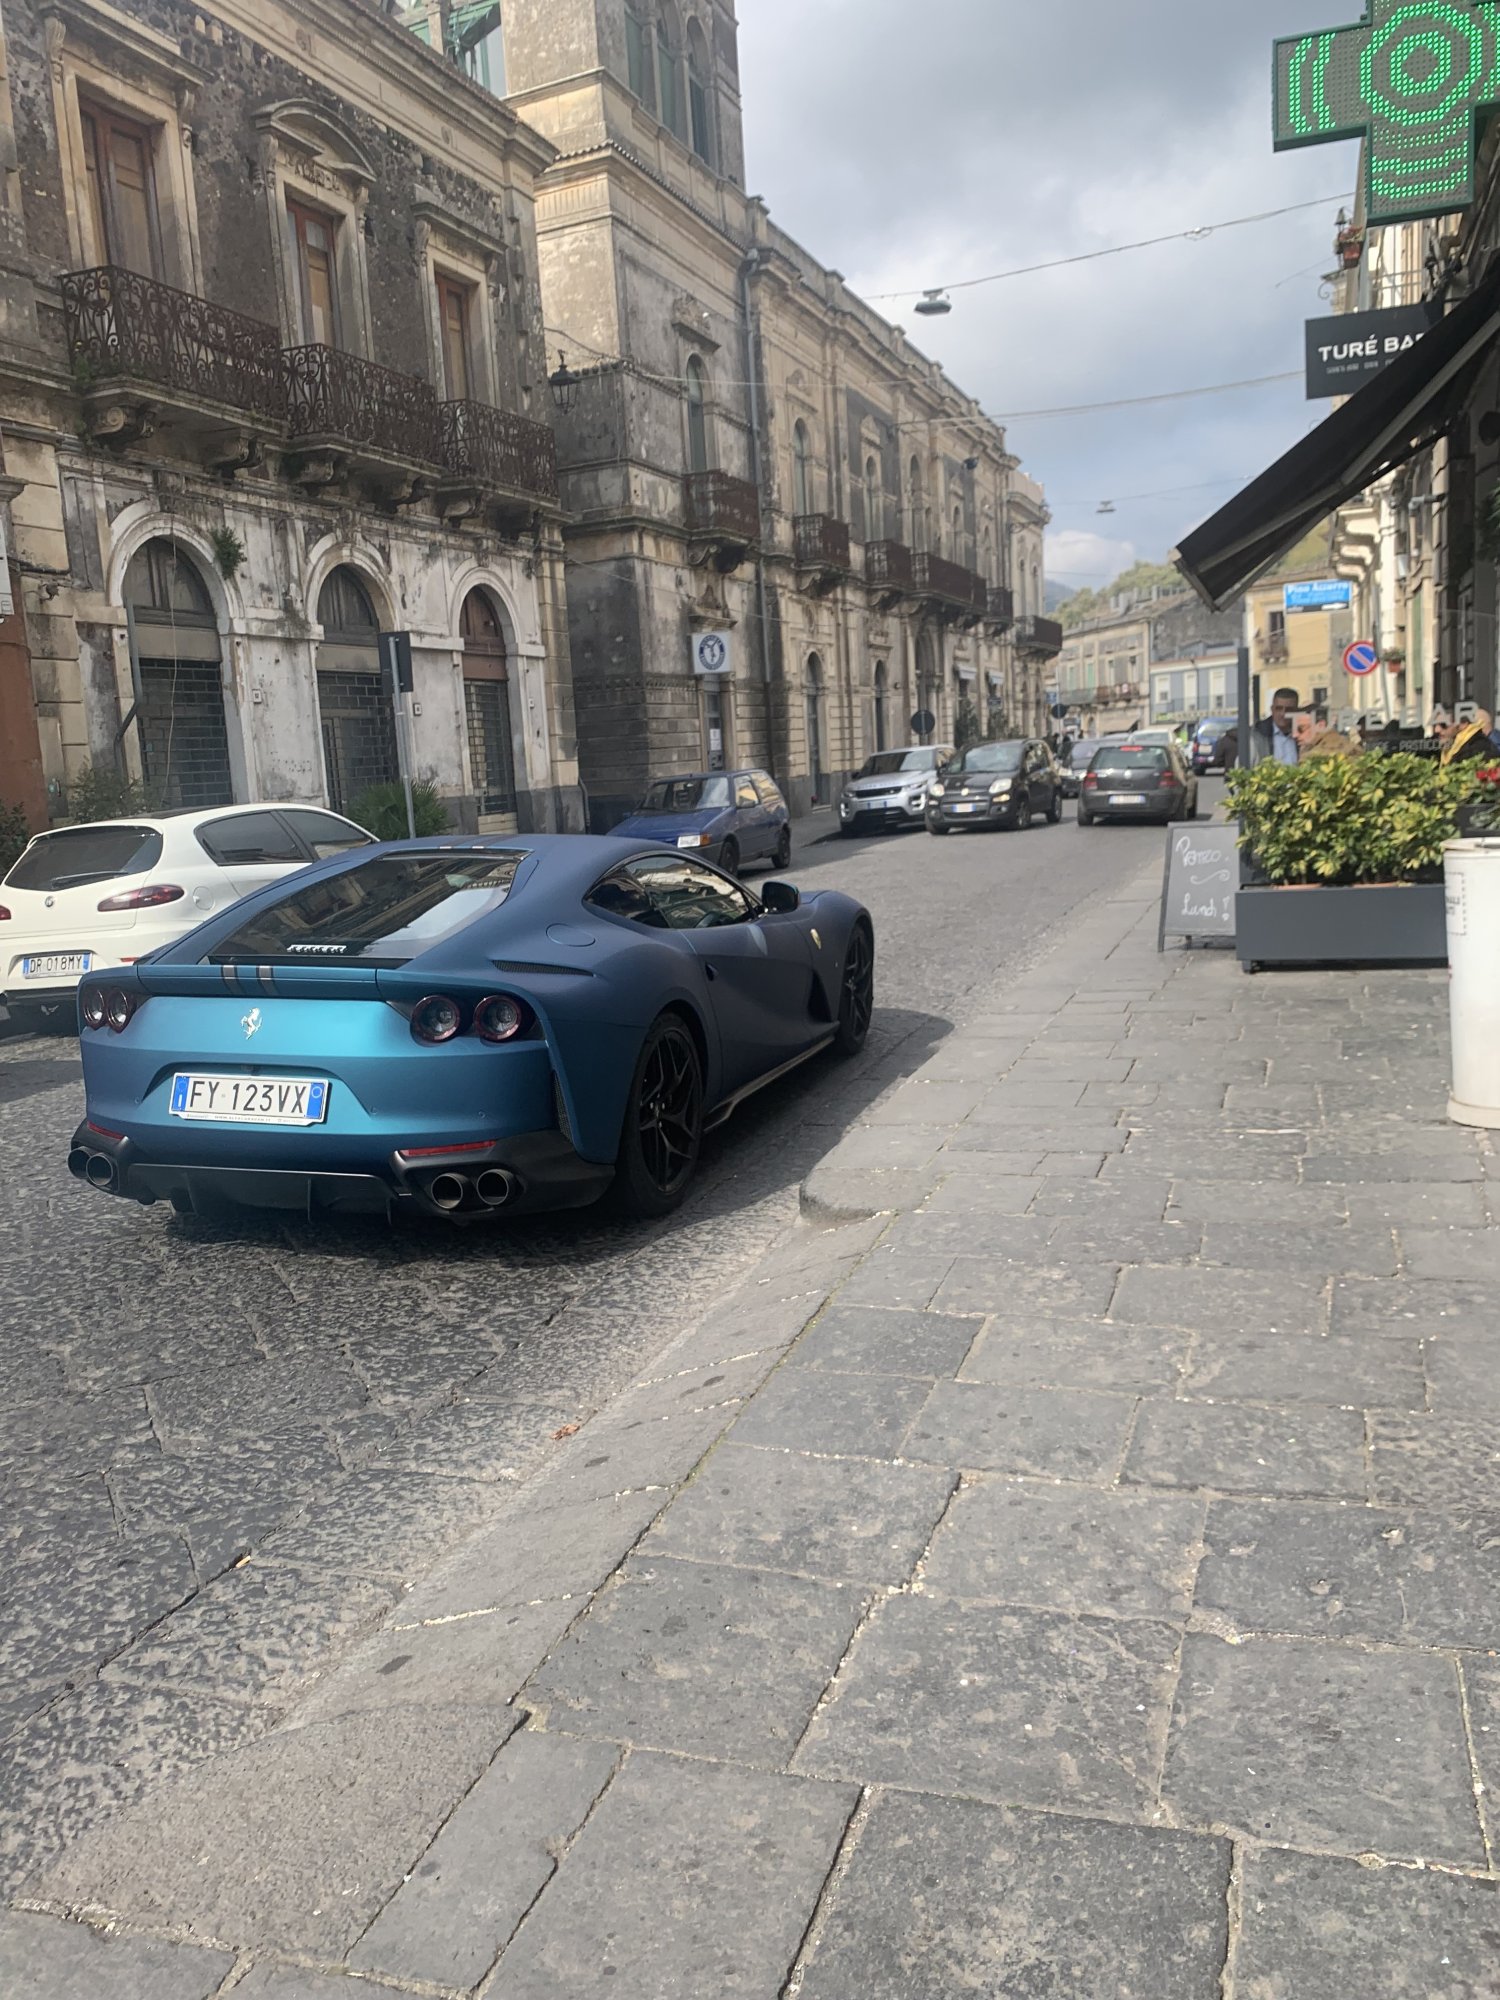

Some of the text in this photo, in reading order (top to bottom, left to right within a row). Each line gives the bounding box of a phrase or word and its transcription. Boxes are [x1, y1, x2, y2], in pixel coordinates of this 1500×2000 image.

[1318, 333, 1378, 362] TURÉ
[30, 955, 82, 973] DR 018MY
[189, 1080, 307, 1114] FY 123VX
